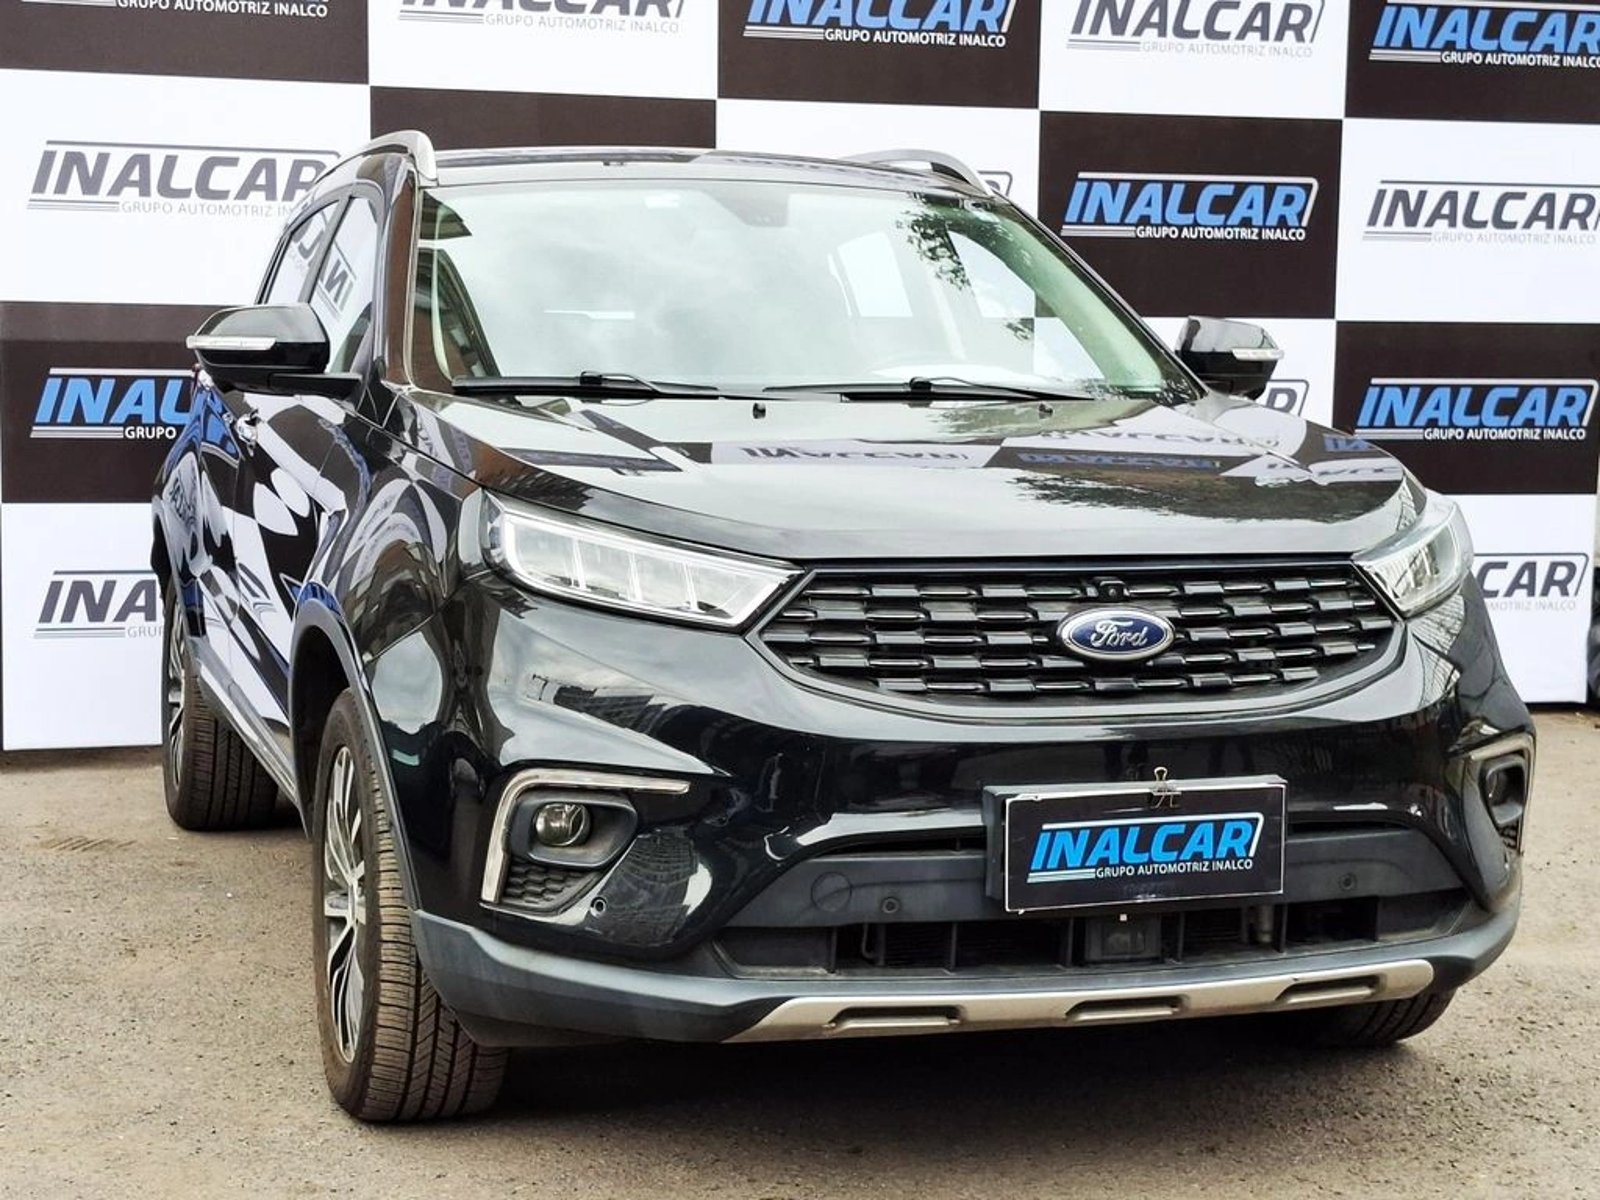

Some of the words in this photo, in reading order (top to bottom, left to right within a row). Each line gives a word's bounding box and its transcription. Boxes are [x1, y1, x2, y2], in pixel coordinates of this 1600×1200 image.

[174, 0, 270, 15] AUTOMOTRIZ
[274, 4, 328, 17] INALCO
[485, 14, 534, 27] GRUPO
[538, 16, 626, 32] AUTOMOTRIZ
[630, 21, 679, 34] INALCO
[1070, 0, 1314, 43] INALCAR
[1373, 5, 1600, 54] INALCAR
[825, 28, 870, 42] GRUPO
[873, 30, 956, 46] AUTOMOTRIZ
[959, 34, 1006, 48] INALCO
[1142, 42, 1185, 53] GRUPO
[1188, 43, 1266, 57] AUTOMOTRIZ
[1268, 46, 1313, 58] INALCO
[1441, 51, 1484, 65] GRUPO
[1485, 53, 1560, 67] AUTOMOTRIZ
[31, 150, 328, 203] INALCAR
[122, 200, 173, 214] GRUPO
[178, 203, 272, 217] AUTOMOTRIZ
[1065, 180, 1306, 227] INALCAR
[1367, 188, 1596, 231] INALCAR
[1136, 226, 1178, 239] GRUPO
[1181, 227, 1259, 240] AUTOMOTRIZ
[1262, 228, 1306, 241] INALCO
[1433, 231, 1473, 242] GRUPO
[1477, 232, 1550, 244] AUTOMOTRIZ
[1553, 234, 1596, 245] INALCO
[34, 377, 192, 425] INAL
[1357, 386, 1587, 428] INALCAR
[124, 426, 177, 440] GRUPO
[1424, 428, 1464, 440] GRUPO
[1466, 428, 1540, 440] AUTOMOTRIZ
[1543, 428, 1586, 440] INALCO
[1090, 619, 1148, 648] Ford
[1031, 820, 1253, 870] INALCAR
[1096, 863, 1135, 878] GRUPO
[1137, 861, 1209, 876] AUTOMOTRIZ
[1211, 858, 1253, 871] INALCO
